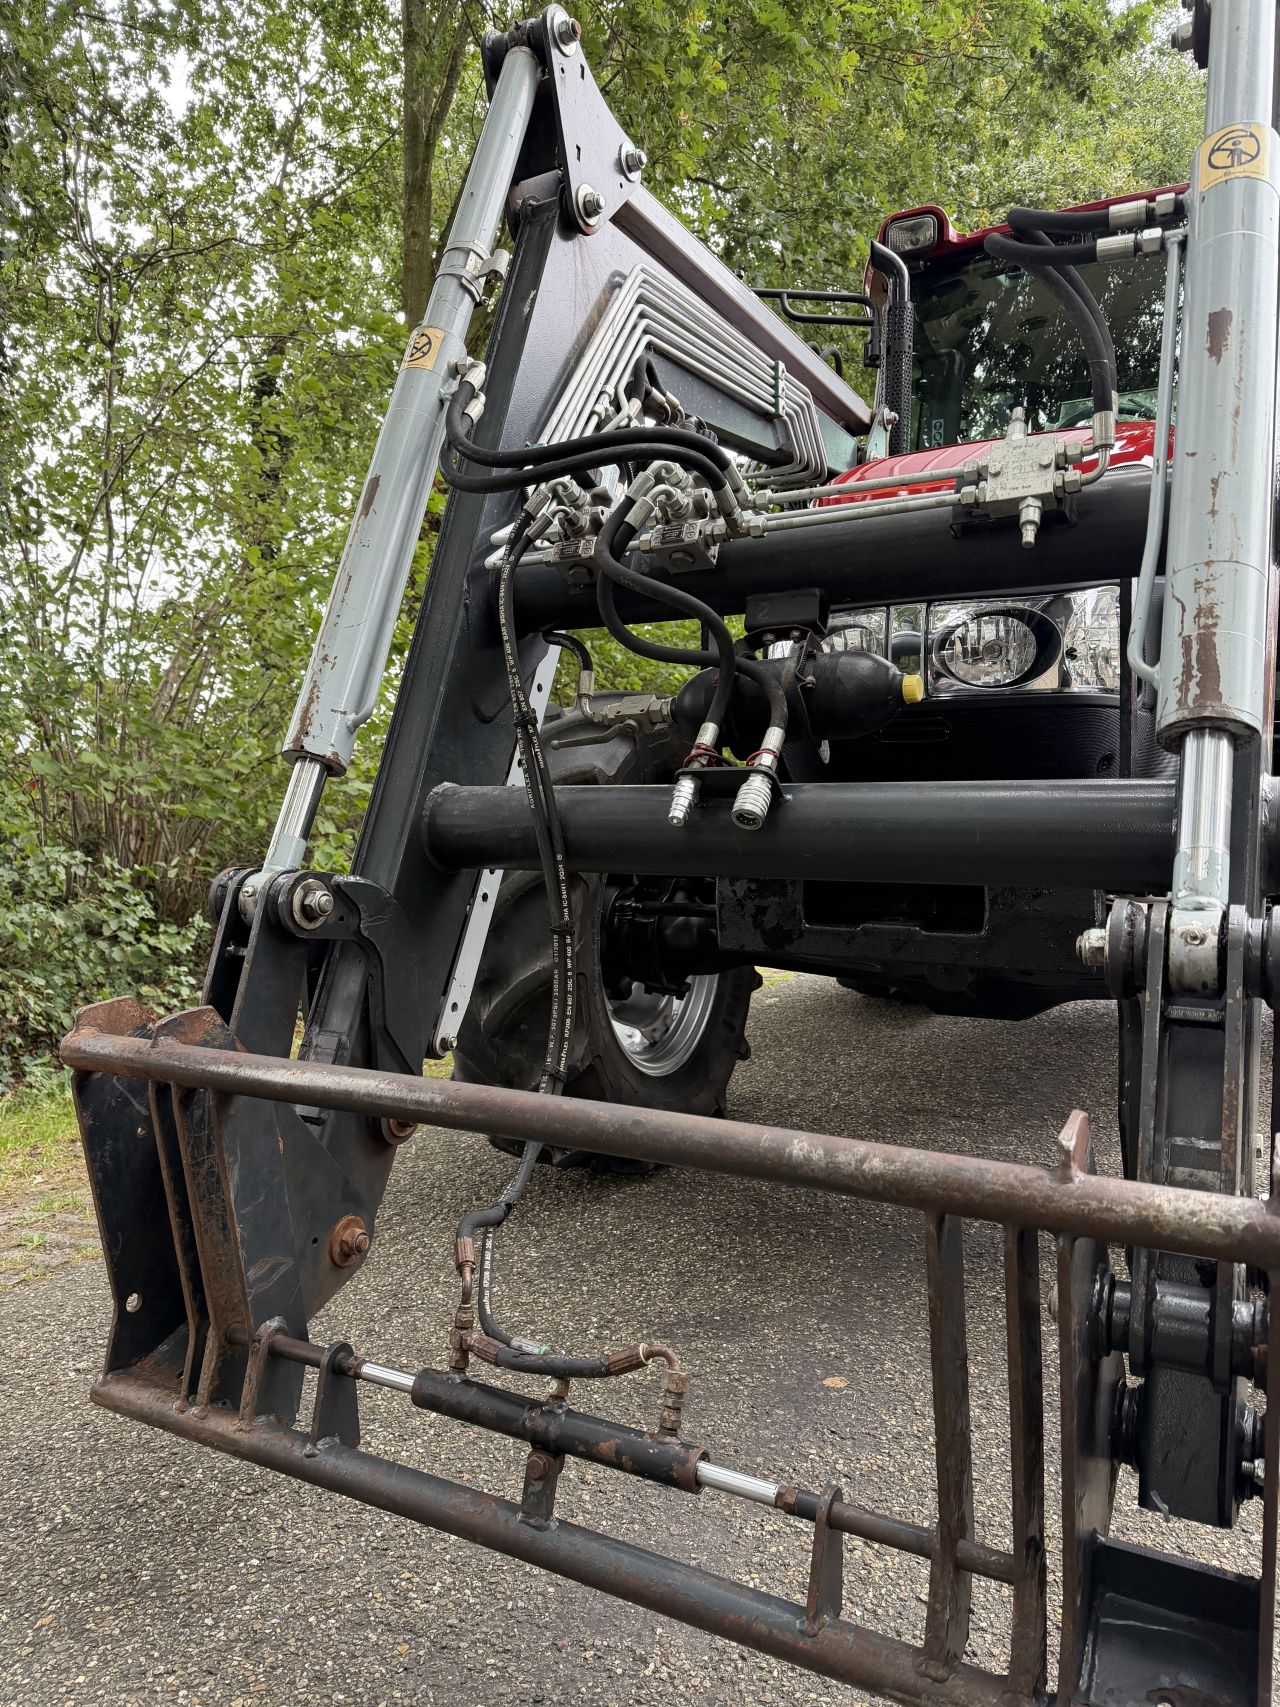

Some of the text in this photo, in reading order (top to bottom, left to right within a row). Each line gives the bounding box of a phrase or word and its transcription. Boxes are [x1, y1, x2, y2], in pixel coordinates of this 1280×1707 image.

[501, 626, 509, 640] BAR
[507, 655, 515, 666] WP
[517, 690, 525, 701] 857
[520, 701, 528, 712] EN
[524, 773, 535, 809] AGRIFLEX
[567, 958, 572, 969] WP
[567, 1006, 572, 1015] EN
[484, 1260, 491, 1269] EN
